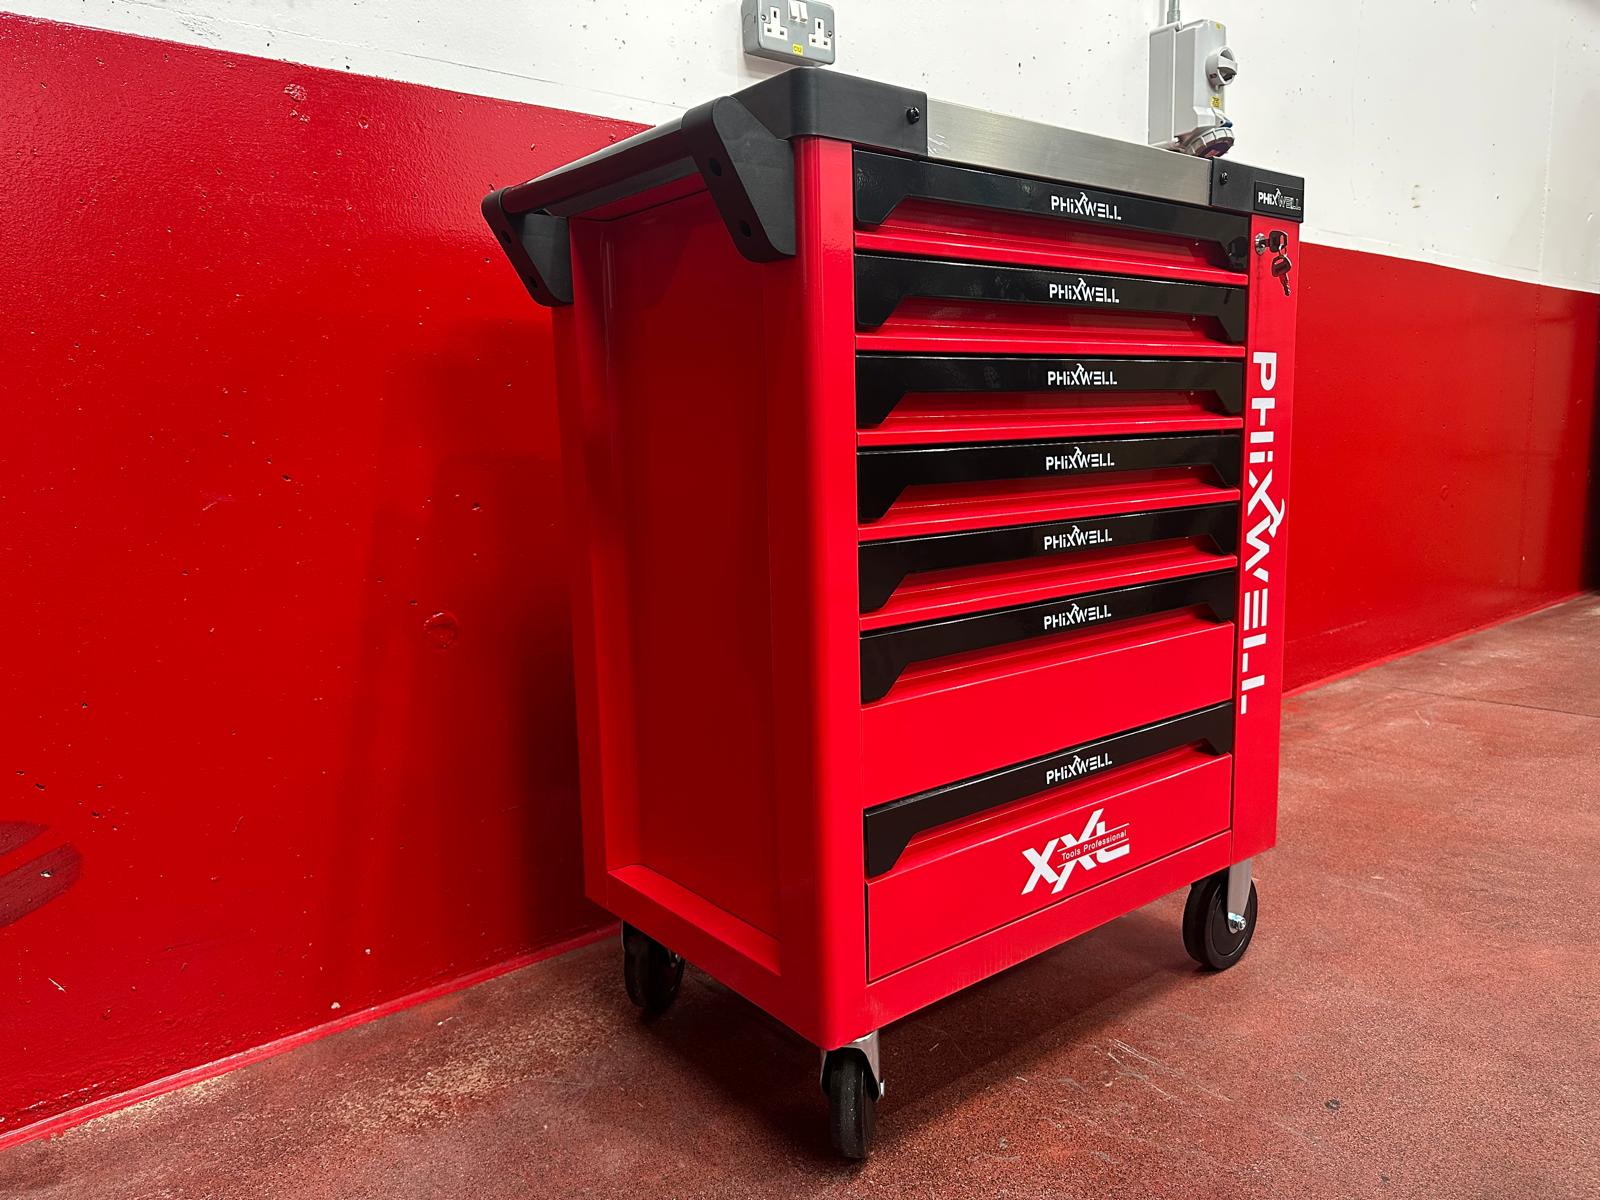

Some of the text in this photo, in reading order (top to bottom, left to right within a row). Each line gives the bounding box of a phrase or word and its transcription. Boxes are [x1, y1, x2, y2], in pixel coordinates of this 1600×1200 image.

[1021, 808, 1130, 895] XXL
[1061, 829, 1127, 861] Tools Professional
